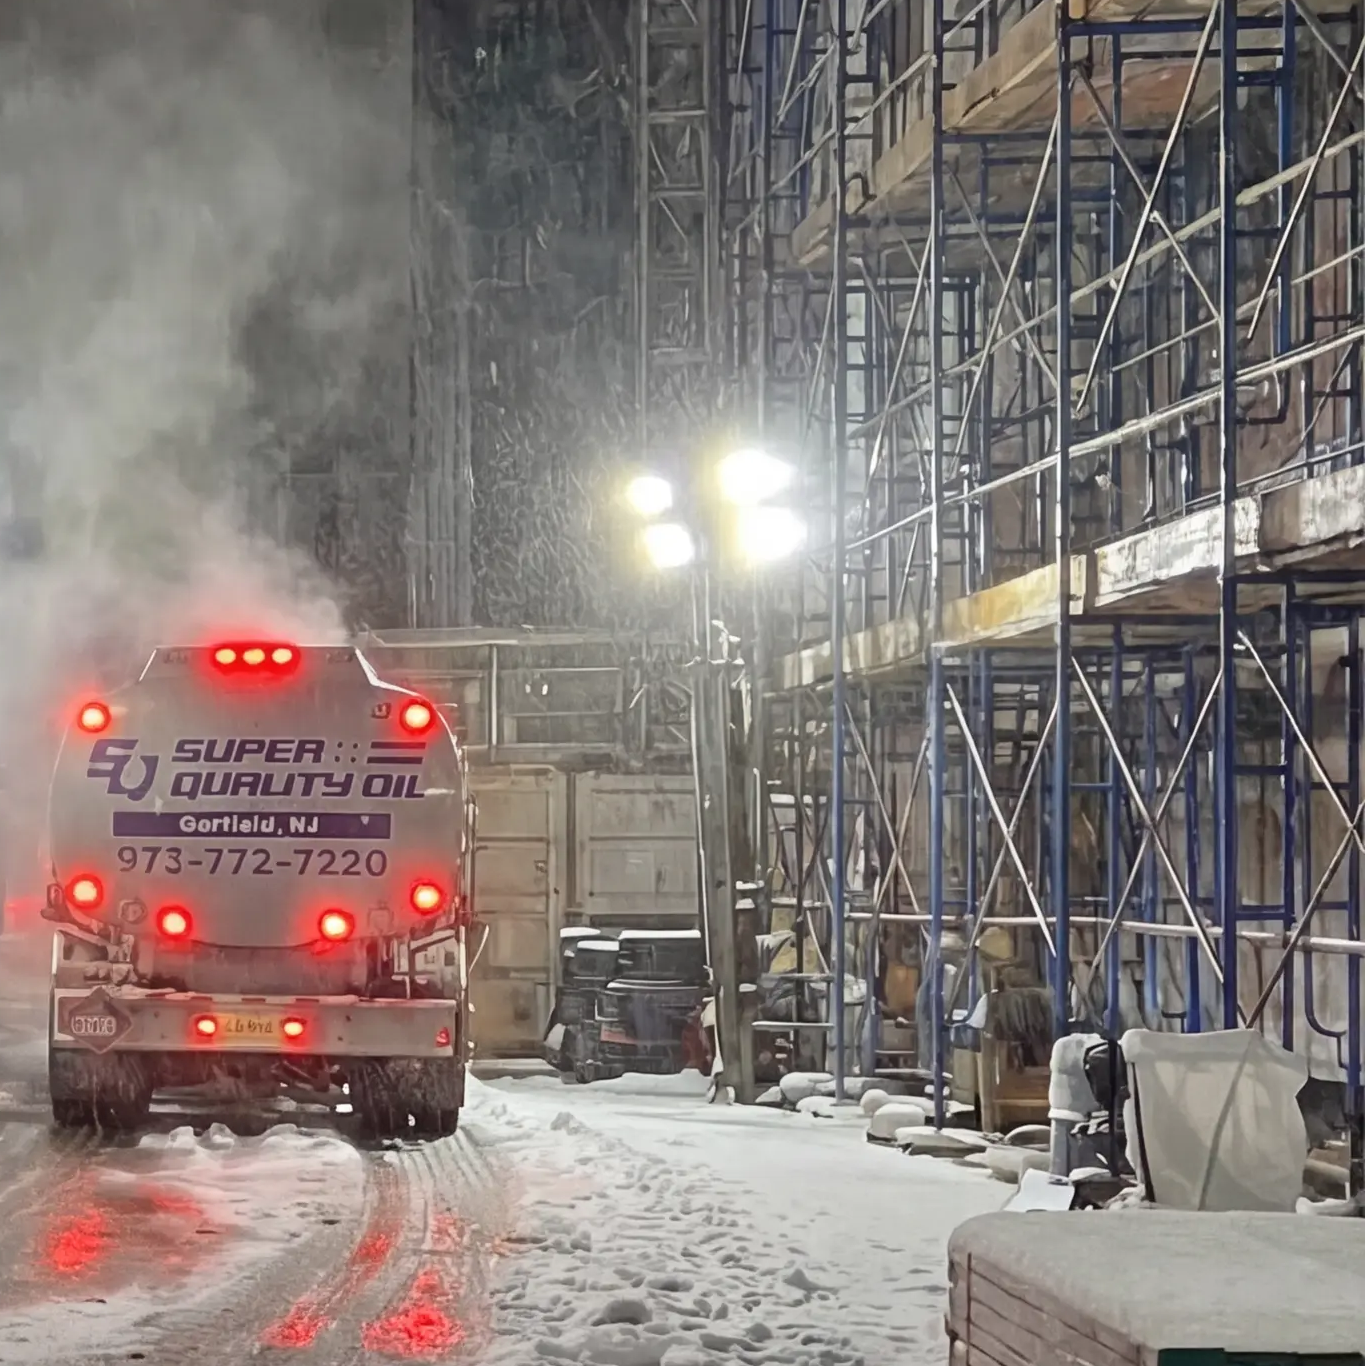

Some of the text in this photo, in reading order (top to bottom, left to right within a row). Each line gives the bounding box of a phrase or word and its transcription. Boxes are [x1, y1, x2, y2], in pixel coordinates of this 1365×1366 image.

[171, 739, 325, 764] SUPER
[170, 772, 426, 800] QUALITY OIL
[290, 815, 319, 834] NJ
[117, 846, 388, 878] 973-772-7220
